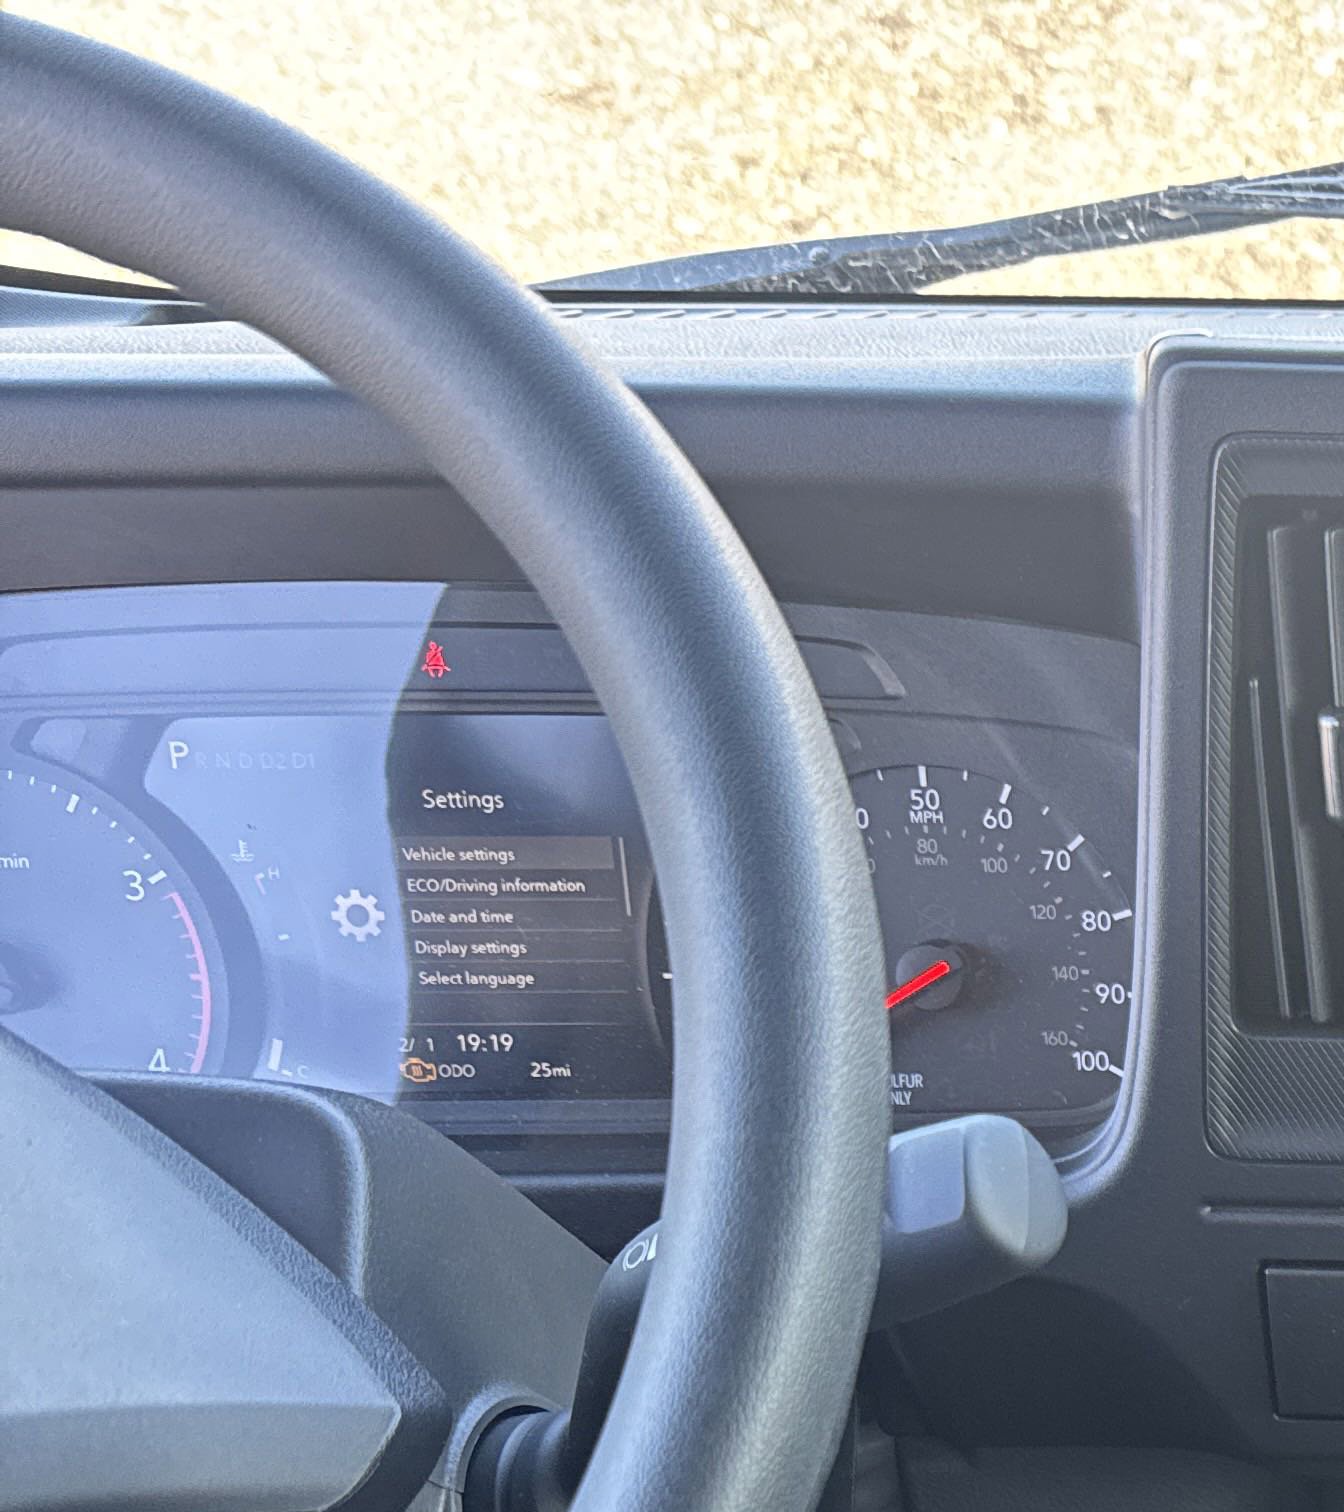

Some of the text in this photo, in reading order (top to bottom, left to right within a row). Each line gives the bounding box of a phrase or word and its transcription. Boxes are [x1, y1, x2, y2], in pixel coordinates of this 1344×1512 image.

[168, 740, 190, 769] P
[421, 788, 505, 814] Settings
[910, 788, 940, 811] 50
[855, 808, 869, 829] 0
[909, 810, 944, 824] MPH
[982, 808, 1013, 830] 60
[916, 838, 939, 854] 80
[401, 847, 516, 864] Vehicle settings
[914, 854, 949, 867] km/h
[1040, 849, 1071, 872] 70
[980, 857, 1009, 873] 100
[122, 869, 146, 902] 3
[406, 877, 586, 896] ECO/Driving information
[411, 910, 515, 924] Date and time
[1029, 904, 1057, 920] 120
[1080, 909, 1113, 932] 80
[415, 941, 528, 958] Display settings
[418, 971, 535, 988] Select language
[1051, 965, 1079, 982] 140
[1094, 982, 1125, 1005] 90
[456, 1033, 514, 1052] 19:19
[1041, 1030, 1068, 1047] 160
[147, 1047, 170, 1073] 4
[1071, 1050, 1110, 1072] 100
[438, 1062, 573, 1078] ODO 25mi
[889, 1090, 913, 1106] NLY
